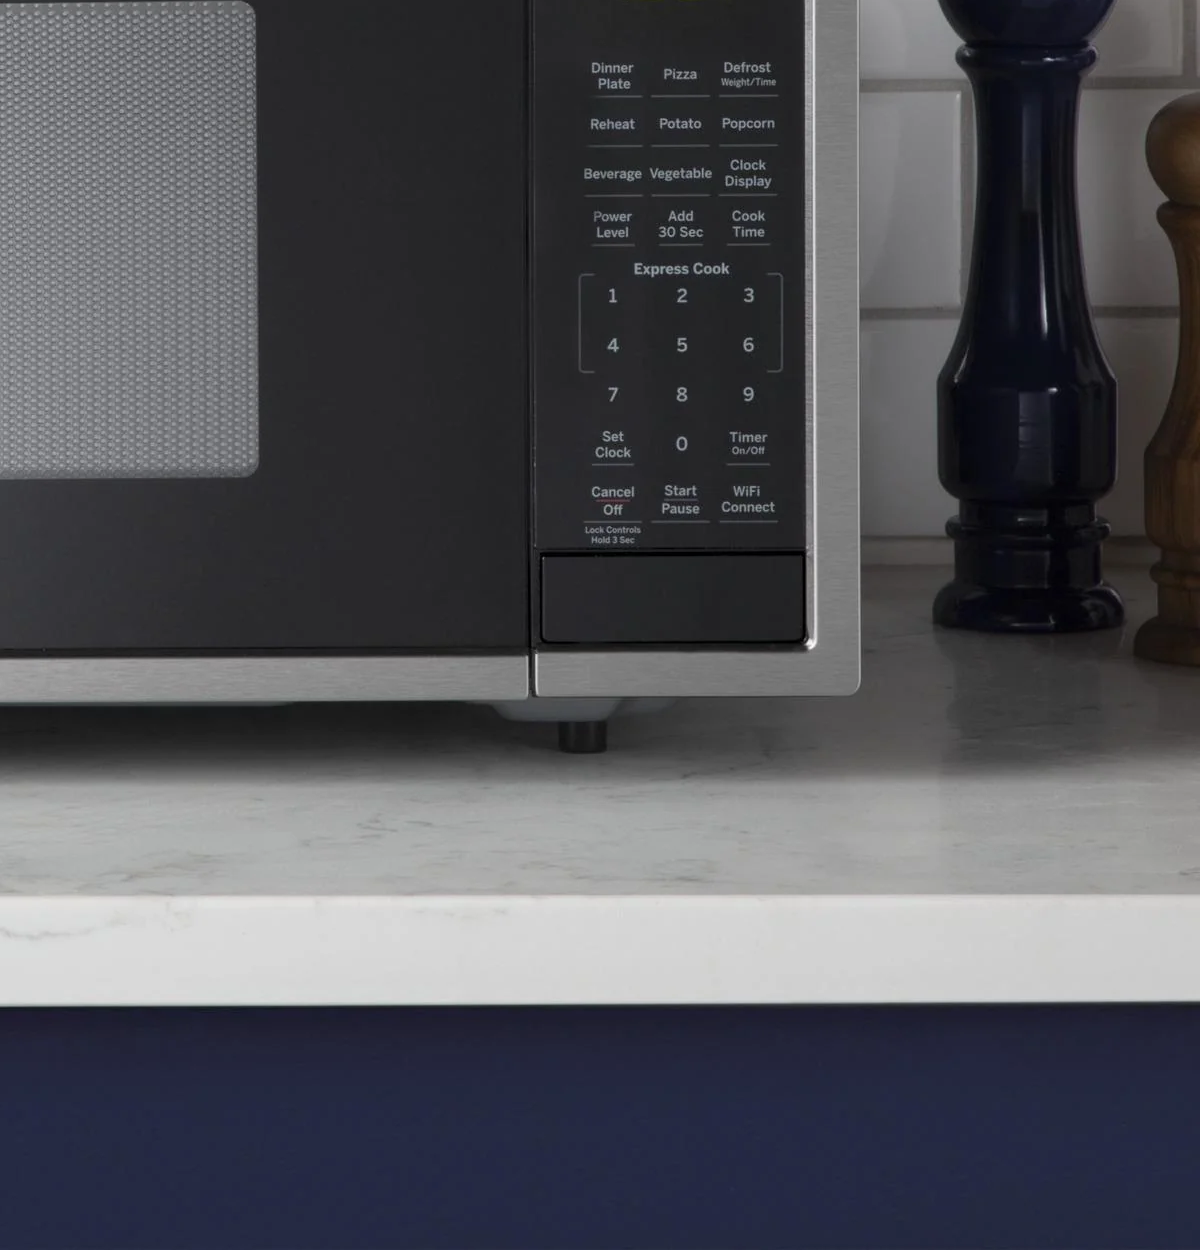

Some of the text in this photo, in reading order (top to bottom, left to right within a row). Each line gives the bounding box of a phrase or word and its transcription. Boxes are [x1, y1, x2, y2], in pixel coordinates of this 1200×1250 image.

[591, 61, 634, 74] Dinner
[663, 68, 698, 80] Pizza
[723, 61, 772, 74] Defrost
[598, 77, 631, 90] Plate
[720, 77, 777, 88] Weight/Time
[590, 118, 636, 131] Reheat
[659, 117, 702, 130] Potato
[722, 117, 776, 132] Popcorn
[729, 158, 767, 171] Clock
[583, 167, 643, 182] Beverage
[649, 167, 713, 182] Vegetable
[724, 174, 772, 189] Display
[593, 210, 633, 223] Power
[667, 210, 694, 222] Add
[731, 209, 766, 222] Cook
[596, 226, 629, 239] Level
[658, 225, 704, 238] 30 Sec
[732, 225, 766, 238] Time
[633, 261, 730, 278] Express Cook
[608, 288, 618, 304] 1
[676, 287, 688, 303] 2
[743, 287, 755, 303] 3
[607, 337, 620, 353] 4
[676, 337, 688, 353] 5
[742, 337, 755, 353] 6
[607, 386, 619, 402] 7
[676, 386, 688, 403] 8
[743, 386, 755, 402] 9
[602, 430, 625, 443] Set
[729, 431, 768, 443] Timer
[675, 436, 689, 452] 0
[731, 446, 765, 455] On/Off
[594, 446, 632, 459] Clock
[591, 485, 635, 498] Cancel
[664, 484, 697, 497] Start
[732, 485, 761, 497] WiFi
[603, 503, 624, 516] Off
[661, 502, 700, 515] Pause
[721, 500, 776, 513] Connect
[585, 525, 641, 535] Lock Controls
[591, 535, 635, 544] Hold 3 Sec
